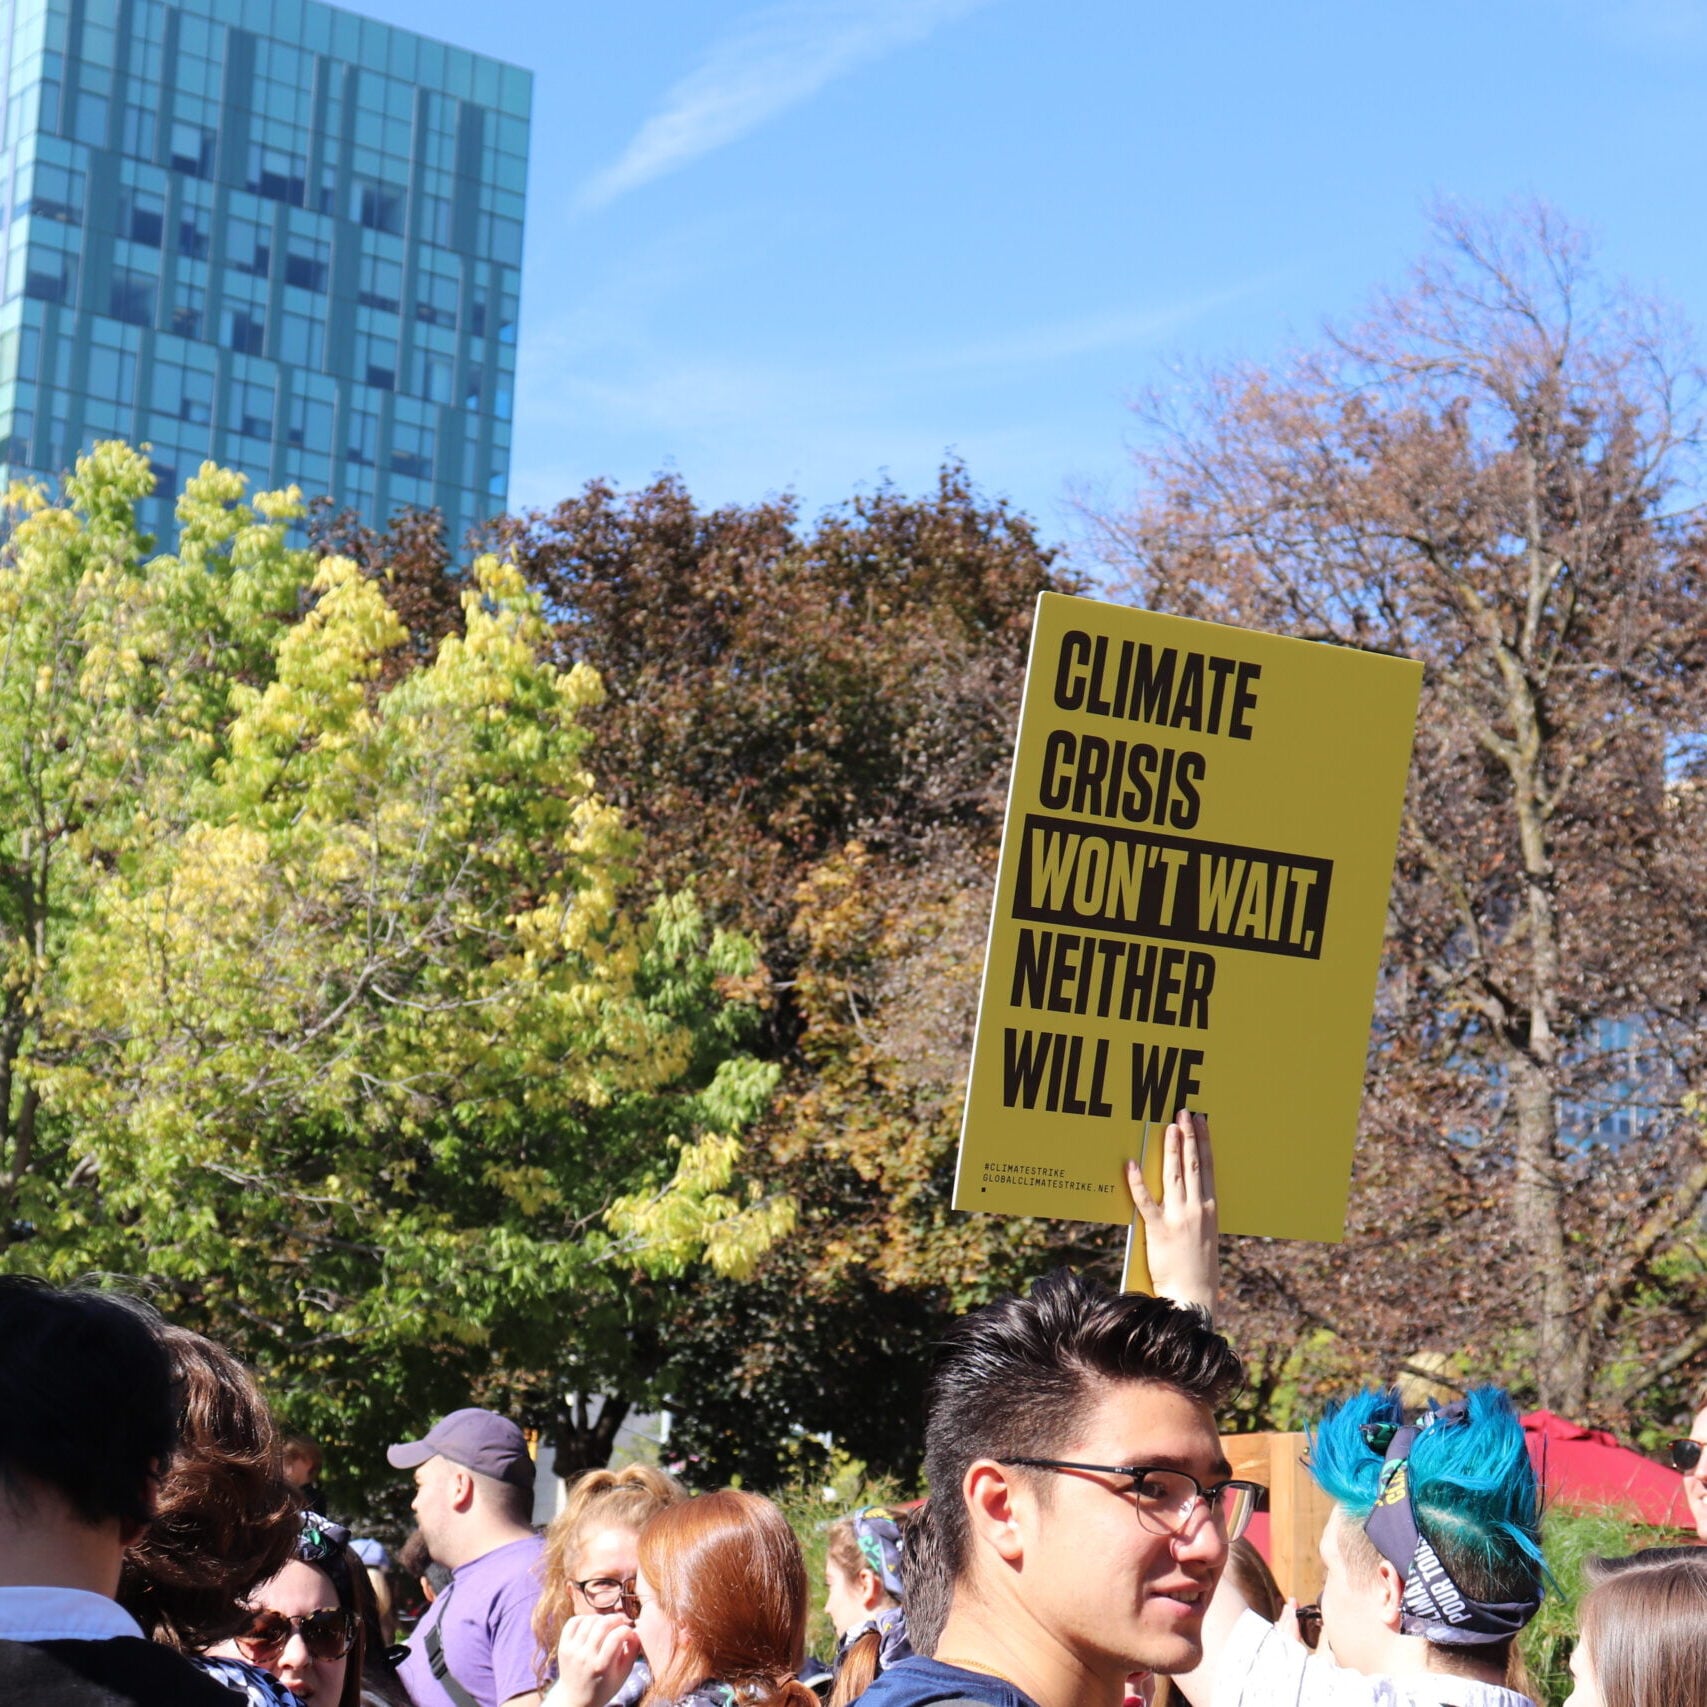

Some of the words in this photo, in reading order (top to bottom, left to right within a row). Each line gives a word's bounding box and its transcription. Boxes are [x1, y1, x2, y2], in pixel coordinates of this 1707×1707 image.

[1055, 631, 1261, 740] CLIMATE
[1040, 730, 1205, 829] CRISIS
[1031, 828, 1189, 926] WON'T
[1011, 929, 1215, 1029] NEITHER
[1004, 1028, 1112, 1117] WILL
[983, 1174, 1116, 1193] GLOBALCLIMATESTRIKE.NET
[984, 1163, 1065, 1178] #CLIMATESTRIKE
[1430, 1577, 1472, 1624] POUR
